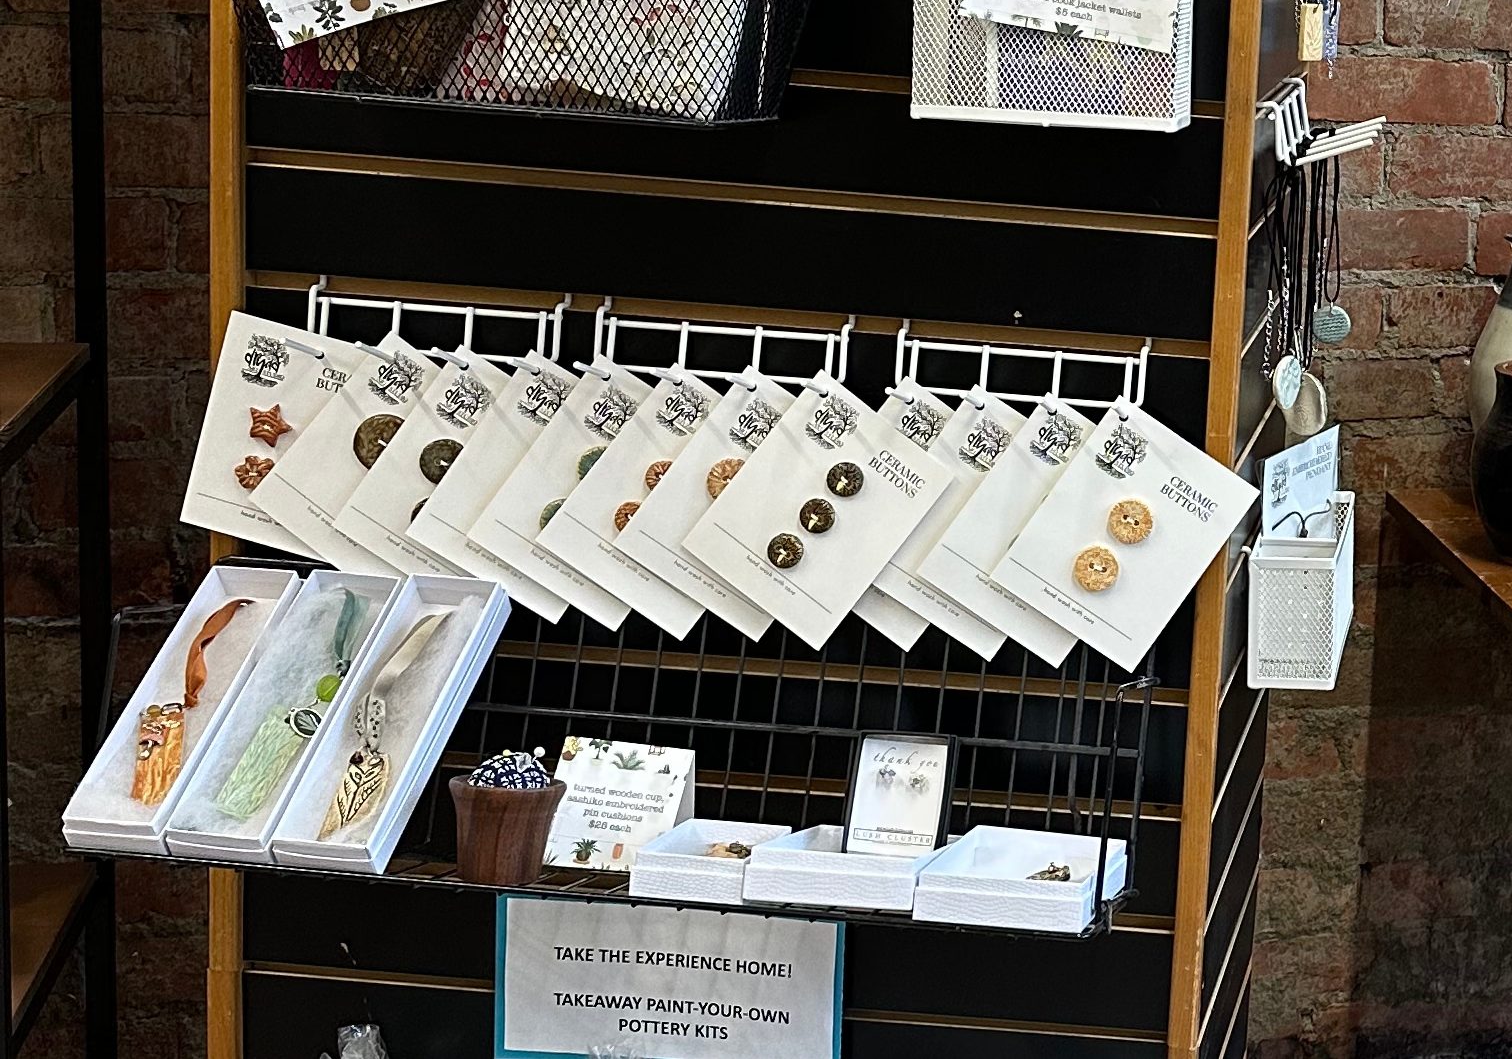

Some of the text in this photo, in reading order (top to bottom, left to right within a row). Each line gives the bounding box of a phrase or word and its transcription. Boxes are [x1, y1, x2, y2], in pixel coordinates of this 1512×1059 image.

[1070, 10, 1092, 22] each
[1109, 6, 1142, 20] wallets
[315, 378, 344, 394] BUT
[868, 456, 918, 499] BUTTONS
[879, 449, 926, 490] CERAMIC
[1160, 484, 1210, 523] BUTTONS
[1170, 476, 1218, 513] CERAMIC
[1043, 587, 1095, 625] hand wash with care
[874, 747, 918, 766] thank
[574, 784, 664, 802] turned wooden cup,
[567, 796, 664, 814] sashiko embroidered
[583, 808, 642, 822] pin cushions
[610, 824, 631, 832] each
[855, 830, 880, 839] LUSH
[554, 946, 792, 978] TAKE THE EXPERIENCE HOME!
[554, 993, 790, 1024] TAKEAWAY PAINT-YOUR-OWN
[619, 1018, 729, 1040] POTTERY KITS
